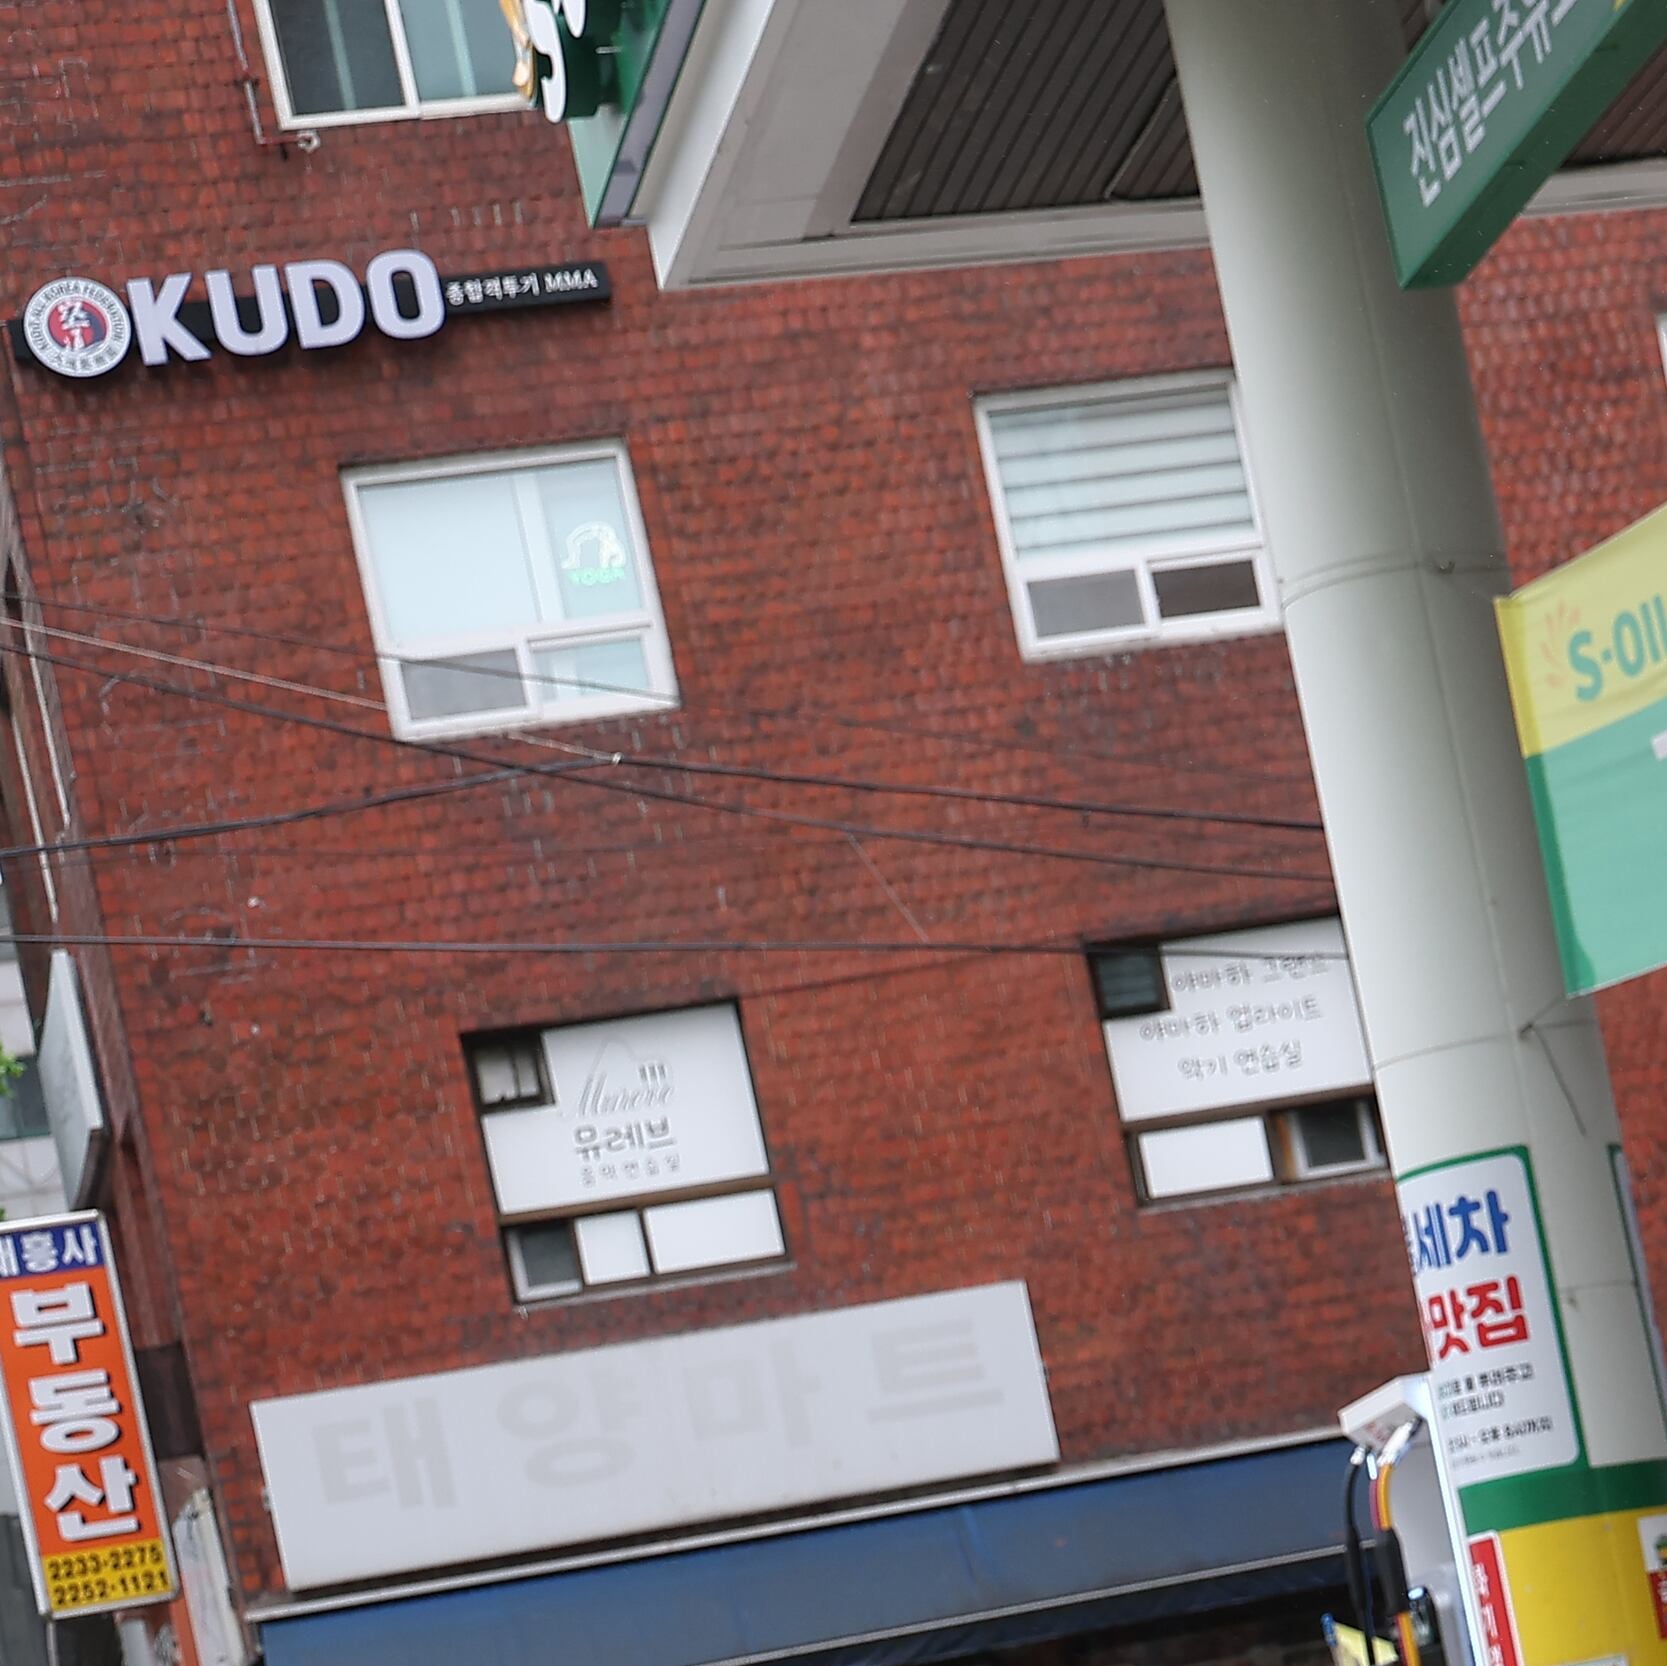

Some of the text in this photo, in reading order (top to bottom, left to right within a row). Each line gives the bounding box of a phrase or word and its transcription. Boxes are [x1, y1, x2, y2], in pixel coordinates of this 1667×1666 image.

[127, 249, 447, 367] KUDO
[544, 268, 599, 294] MMA
[1428, 1276, 1530, 1359] 맛집
[10, 1281, 140, 1543] 부동산
[51, 1569, 169, 1604] 2252-1121
